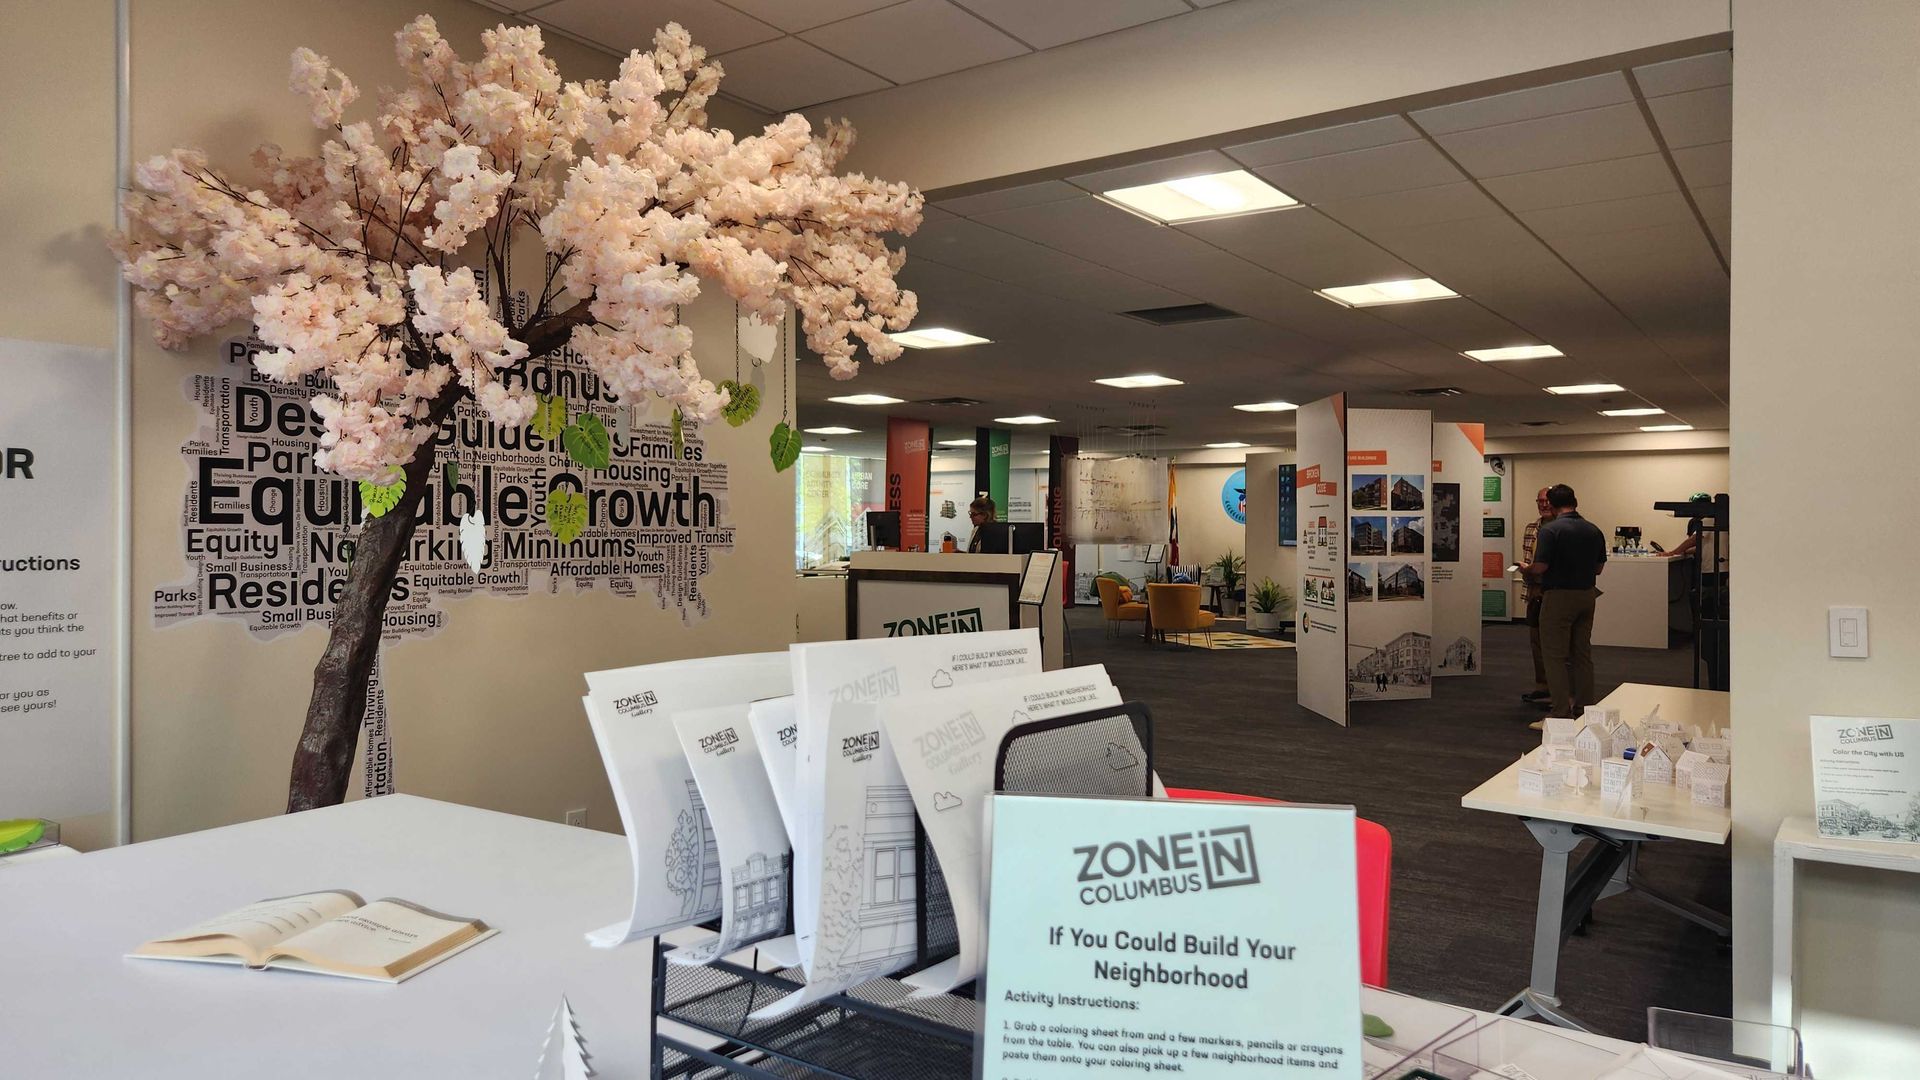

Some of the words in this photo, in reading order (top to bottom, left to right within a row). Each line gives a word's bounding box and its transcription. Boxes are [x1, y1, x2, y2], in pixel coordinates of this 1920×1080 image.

[194, 375, 202, 400] Housing
[270, 385, 306, 398] Density
[220, 377, 232, 455] Transportation
[250, 397, 259, 422] Youth
[189, 440, 209, 448] Parks
[272, 438, 310, 450] Housing
[642, 435, 668, 443] Residents
[181, 447, 218, 456] Families
[475, 453, 545, 463] Neighborhoods
[500, 473, 528, 484] Parks
[318, 478, 327, 511] Housing
[530, 468, 546, 528] Youth
[189, 480, 198, 523] Residents
[214, 501, 250, 510] Families
[534, 529, 552, 537] Equity
[611, 530, 636, 538] Homes
[637, 530, 691, 547] Improved
[695, 531, 733, 543] Transit
[187, 529, 279, 559] Equity
[637, 550, 664, 561] Youth
[206, 563, 237, 572] Small
[240, 563, 287, 571] Business
[404, 563, 442, 572] Equitable
[551, 560, 620, 576] Affordable
[624, 563, 665, 574] Homes
[689, 544, 697, 601] Residents
[414, 573, 474, 590] Equitable
[478, 571, 520, 585] Growth
[610, 580, 633, 590] Equity
[155, 589, 197, 602] Parks
[22, 612, 64, 621] benefits
[262, 608, 301, 623] Small
[382, 612, 436, 627] Housing
[15, 628, 34, 637] you
[38, 624, 64, 633] think
[67, 624, 84, 632] the
[37, 649, 57, 658] add
[73, 649, 96, 658] your
[959, 653, 975, 661] COULD
[996, 648, 1027, 657] NEIGHBORHOOD
[14, 691, 33, 701] you
[24, 700, 56, 712] yours!
[365, 680, 378, 728] Thriving
[375, 689, 385, 736] Residents
[631, 707, 653, 718] Gallery
[1840, 736, 1877, 745] COLUMBUS
[716, 746, 736, 757] Gallery
[1864, 750, 1878, 758] City
[852, 754, 872, 764] Gallery
[1079, 873, 1203, 906] COLUMBUS
[1049, 926, 1064, 946] If
[1070, 927, 1108, 950] You
[1115, 930, 1177, 953] Could
[1184, 934, 1239, 957] Build
[1246, 938, 1296, 961] Your
[1094, 960, 1249, 990] Neighborhood
[1004, 989, 1054, 1008] Activity
[1058, 992, 1140, 1010] Instructions:
[1013, 1021, 1038, 1032] Grab
[1048, 1024, 1089, 1037] coloring
[1091, 1028, 1119, 1038] sheet
[1121, 1028, 1145, 1040] from
[1147, 1031, 1166, 1041] and
[1178, 1033, 1196, 1044] few
[1199, 1036, 1244, 1048] markers,
[1247, 1039, 1284, 1052] pencils
[1287, 1043, 1298, 1051] or
[1300, 1044, 1343, 1056] crayons
[1002, 1035, 1026, 1047] from
[1028, 1037, 1044, 1047] the
[1046, 1038, 1074, 1049] table.
[1078, 1040, 1096, 1051] You
[1098, 1044, 1116, 1052] can
[1119, 1044, 1140, 1054] also
[1142, 1045, 1164, 1058] pick
[1166, 1049, 1179, 1059] up
[1190, 1049, 1209, 1060] few
[1212, 1051, 1284, 1066] neighborhood
[1286, 1057, 1316, 1068] items
[1318, 1059, 1338, 1070] and
[1002, 1051, 1029, 1062] paste
[1032, 1050, 1057, 1063] them
[1059, 1055, 1082, 1065] onto
[1084, 1058, 1106, 1068] your
[1109, 1057, 1151, 1072] coloring
[1153, 1060, 1184, 1072] sheet.
